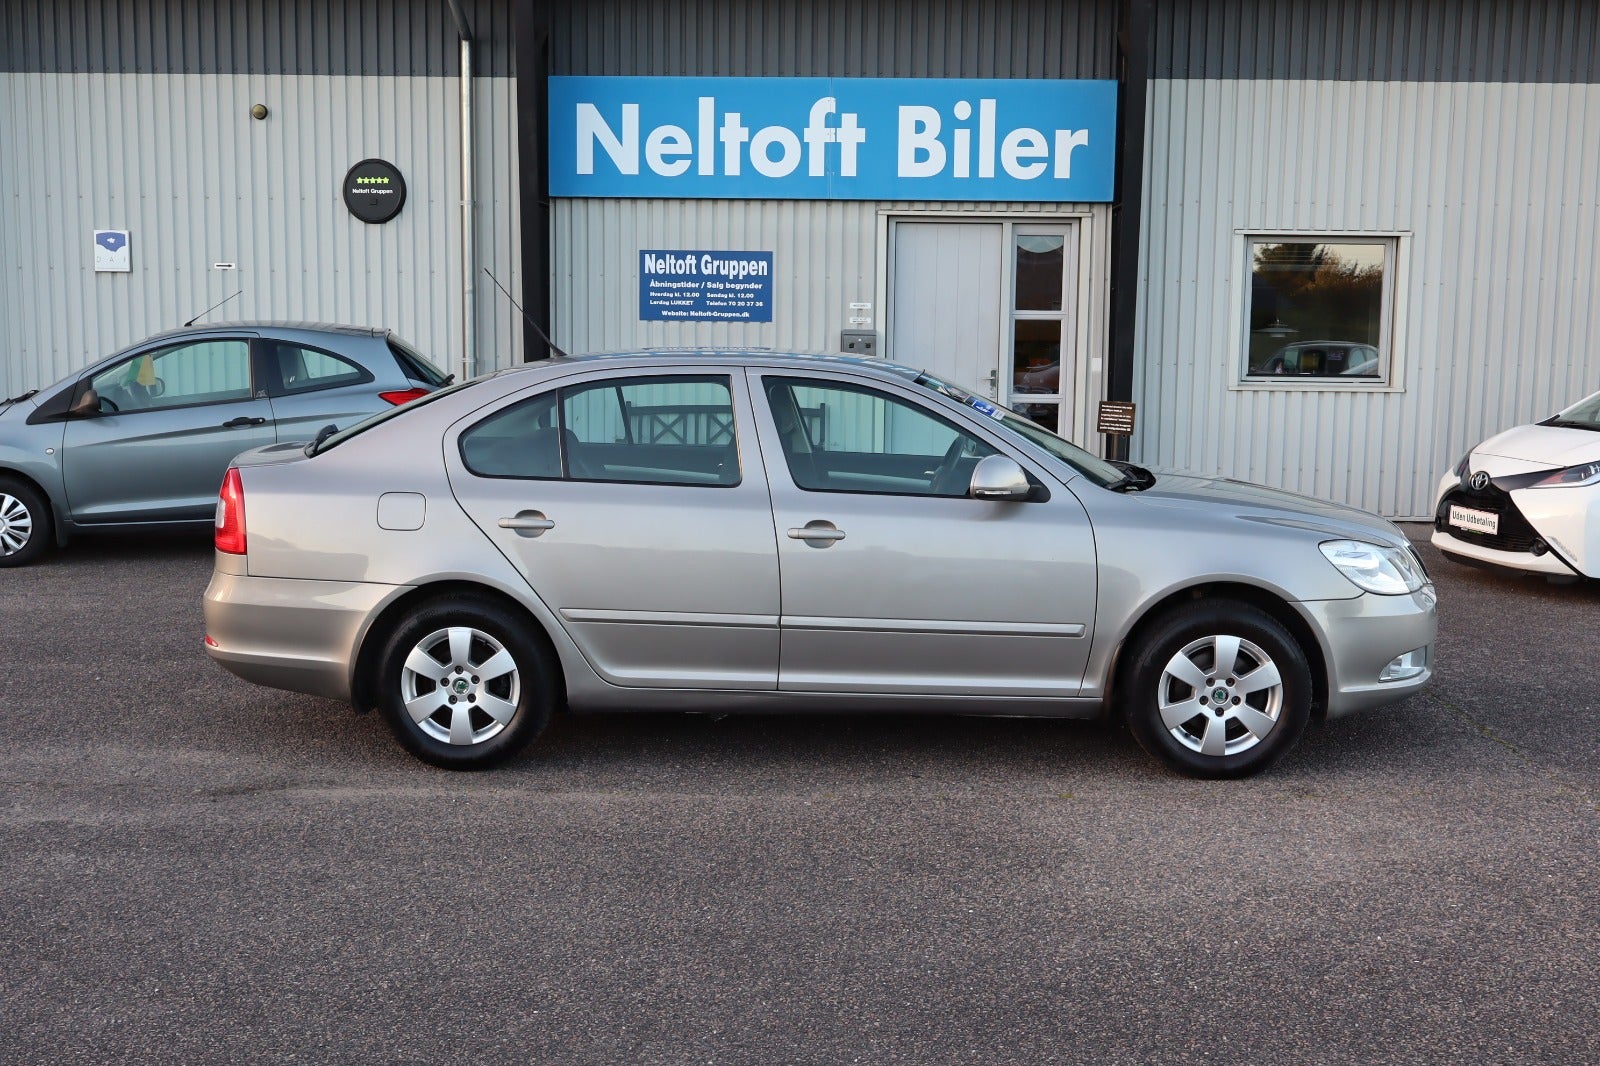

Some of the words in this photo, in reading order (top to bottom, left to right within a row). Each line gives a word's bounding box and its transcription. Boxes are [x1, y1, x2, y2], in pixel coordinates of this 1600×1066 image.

[576, 96, 866, 178] Neltoft
[898, 98, 1089, 180] Biler
[644, 253, 697, 275] Neltoft
[700, 254, 768, 279] Gruppen
[649, 279, 699, 289] Åbningstider
[706, 281, 724, 290] Salg
[725, 281, 763, 290] begynder
[690, 310, 750, 318] Neltoft-Gruppen.dk
[1452, 510, 1466, 521] Uden
[1466, 513, 1496, 529] Udbetaling
